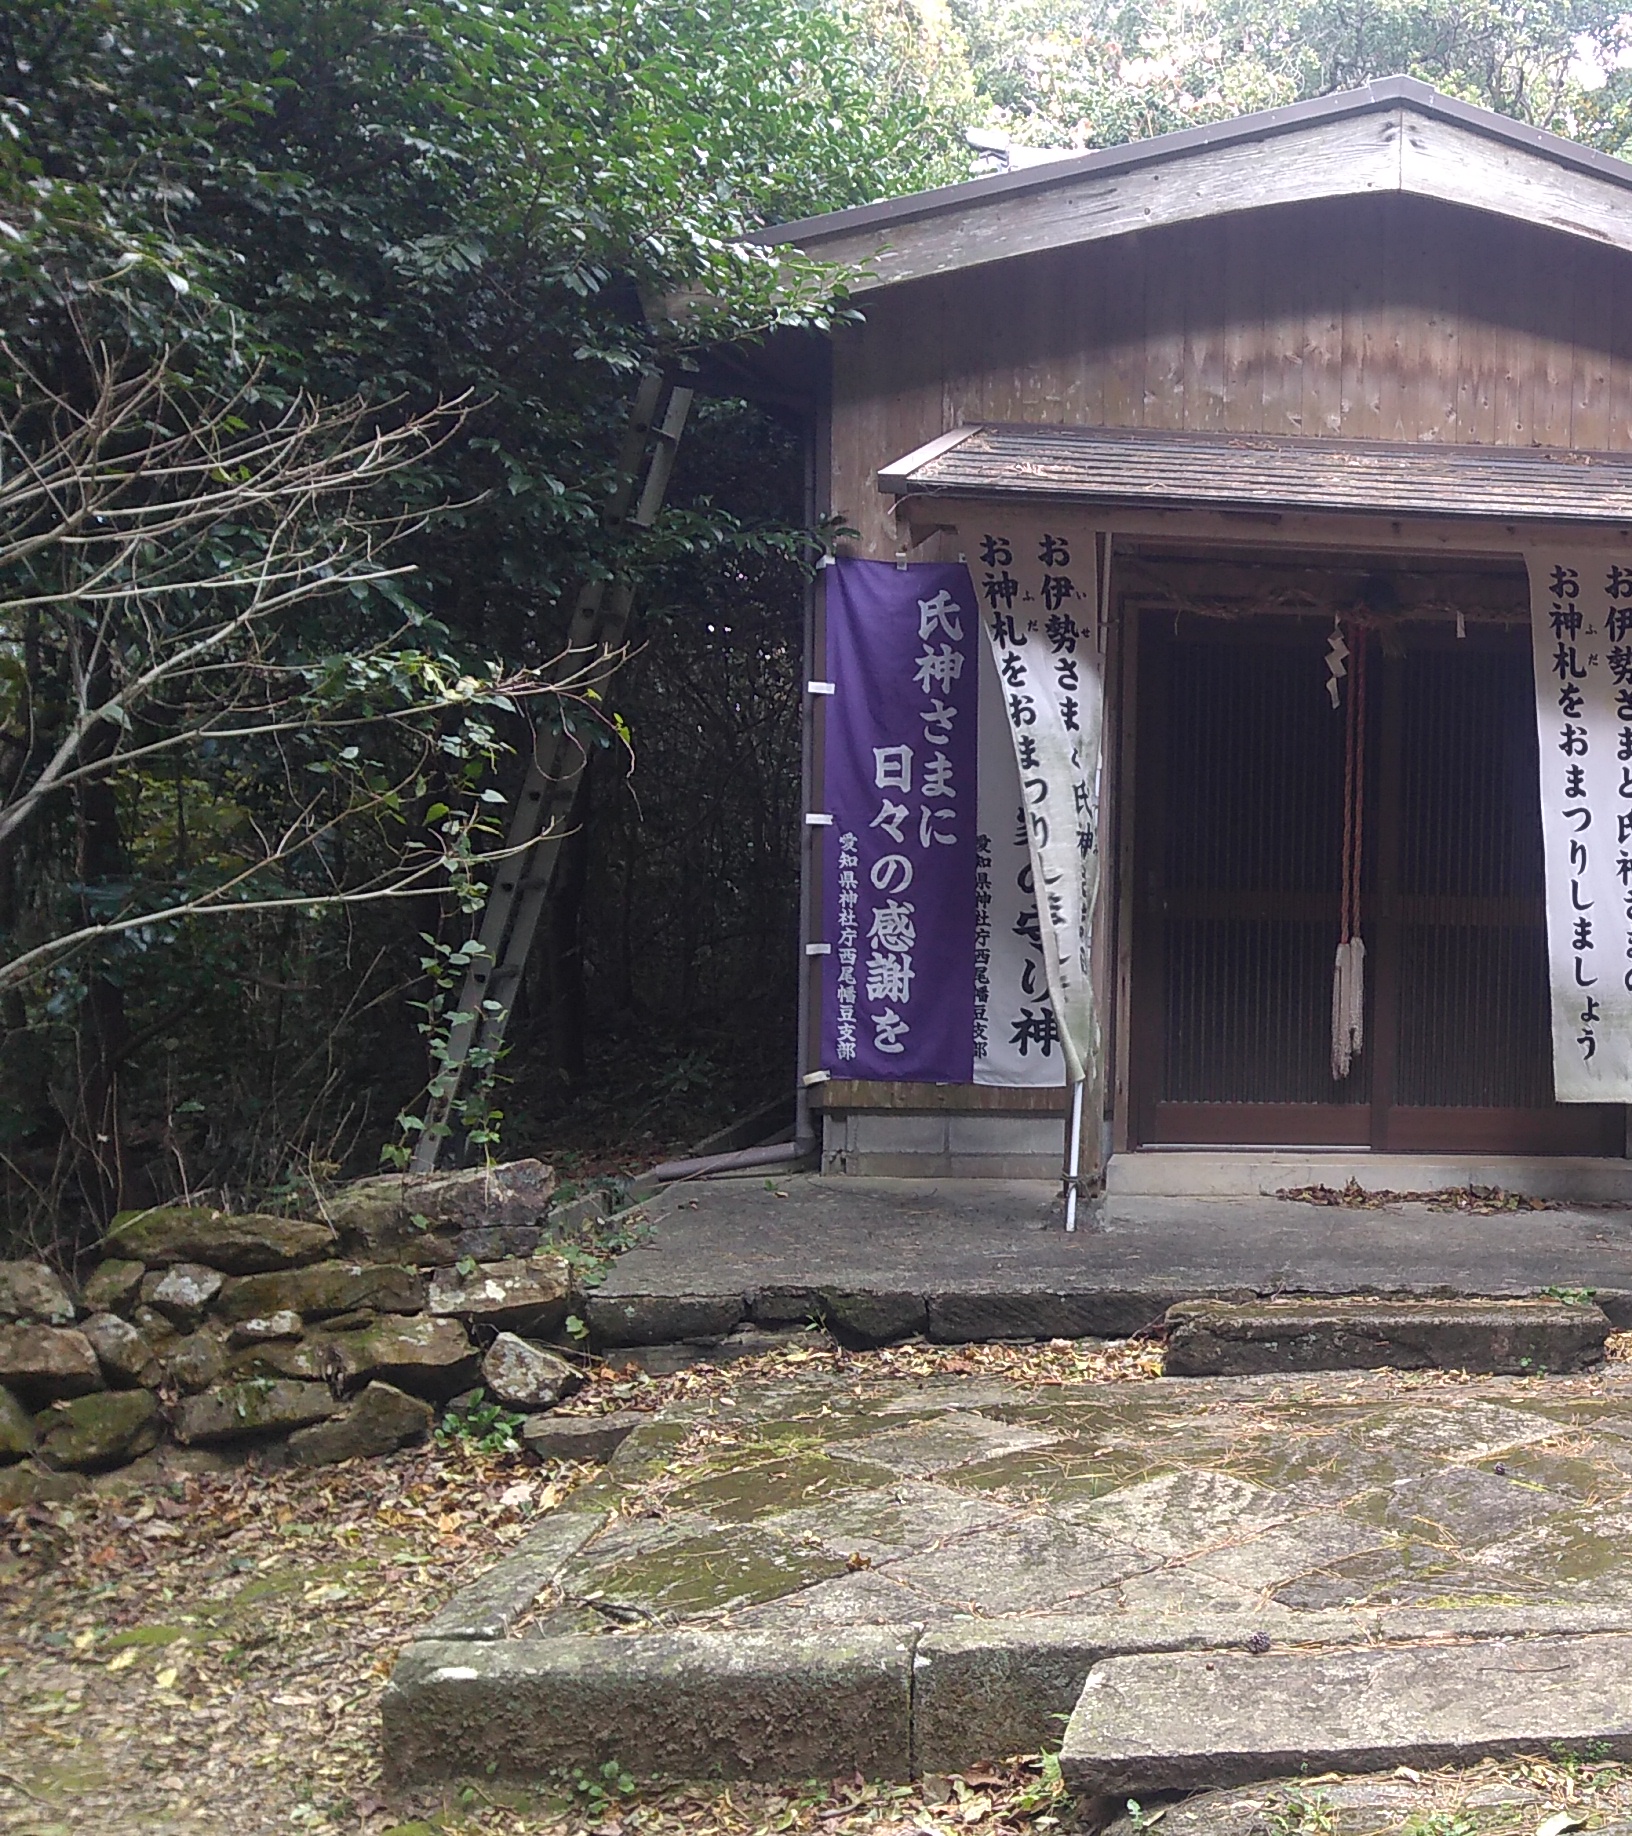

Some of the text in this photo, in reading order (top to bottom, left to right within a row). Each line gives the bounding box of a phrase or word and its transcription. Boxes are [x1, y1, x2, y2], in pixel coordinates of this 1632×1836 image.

[912, 588, 966, 848] 氏神さまに
[1585, 623, 1599, 667] ふだ
[865, 743, 917, 1054] 日々の感謝を
[1548, 564, 1601, 1061] お神札をおまつりしましょう
[836, 831, 860, 1062] 愛知県神社庁西尾幡豆支部
